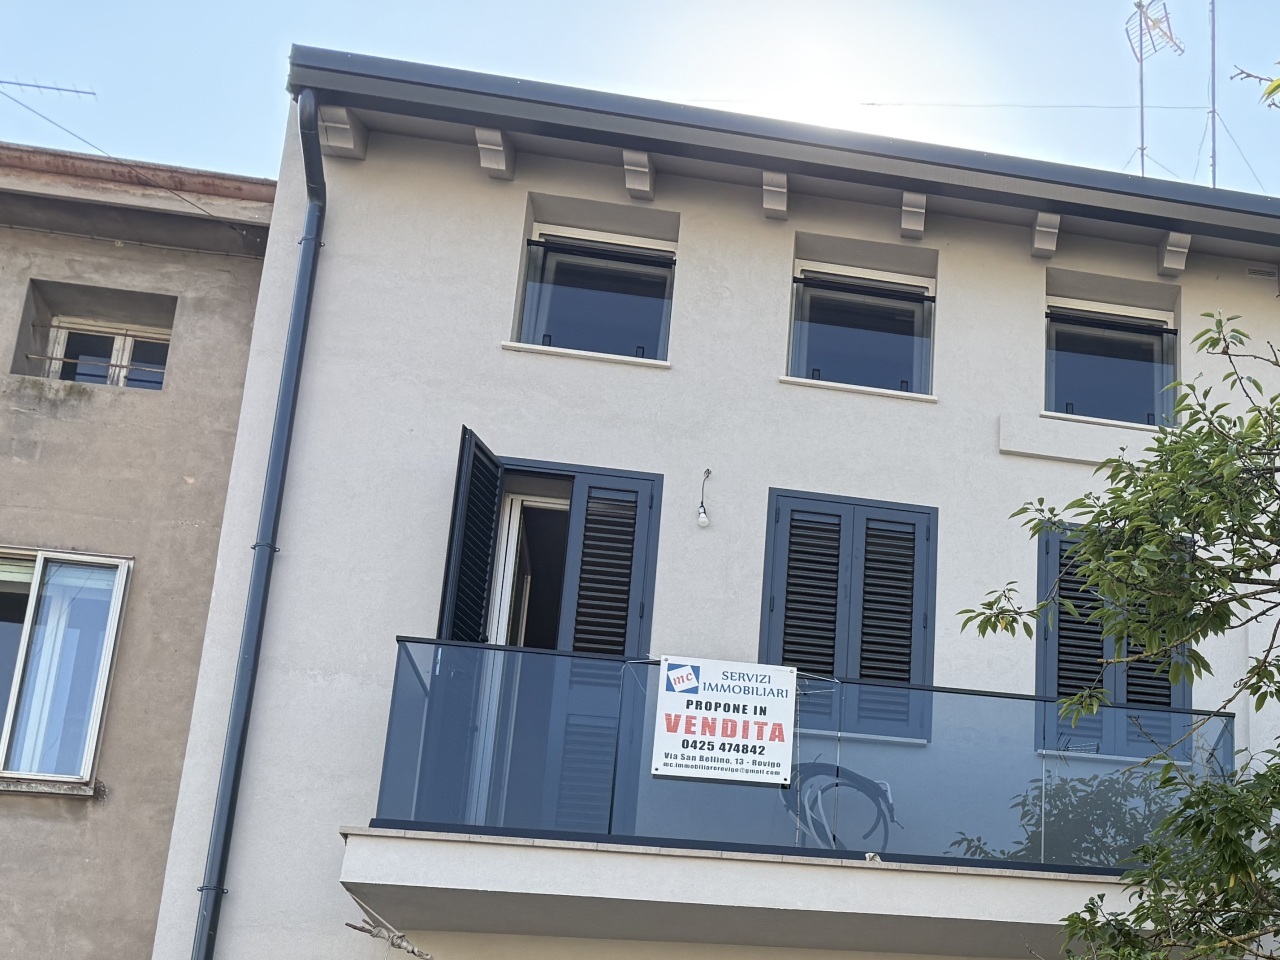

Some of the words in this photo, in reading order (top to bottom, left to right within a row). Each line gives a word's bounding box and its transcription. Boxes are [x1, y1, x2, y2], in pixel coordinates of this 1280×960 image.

[721, 670, 772, 685] SERVIZI
[702, 681, 788, 699] IMMOBILIARI
[685, 699, 748, 715] PROPONE
[753, 705, 767, 716] IN
[664, 713, 785, 743] VENDITA
[681, 738, 715, 751] 0425
[718, 742, 766, 756] 474842
[664, 752, 678, 760] Via
[680, 753, 697, 761] San
[735, 757, 744, 765] 13
[752, 759, 781, 769] Rovigo
